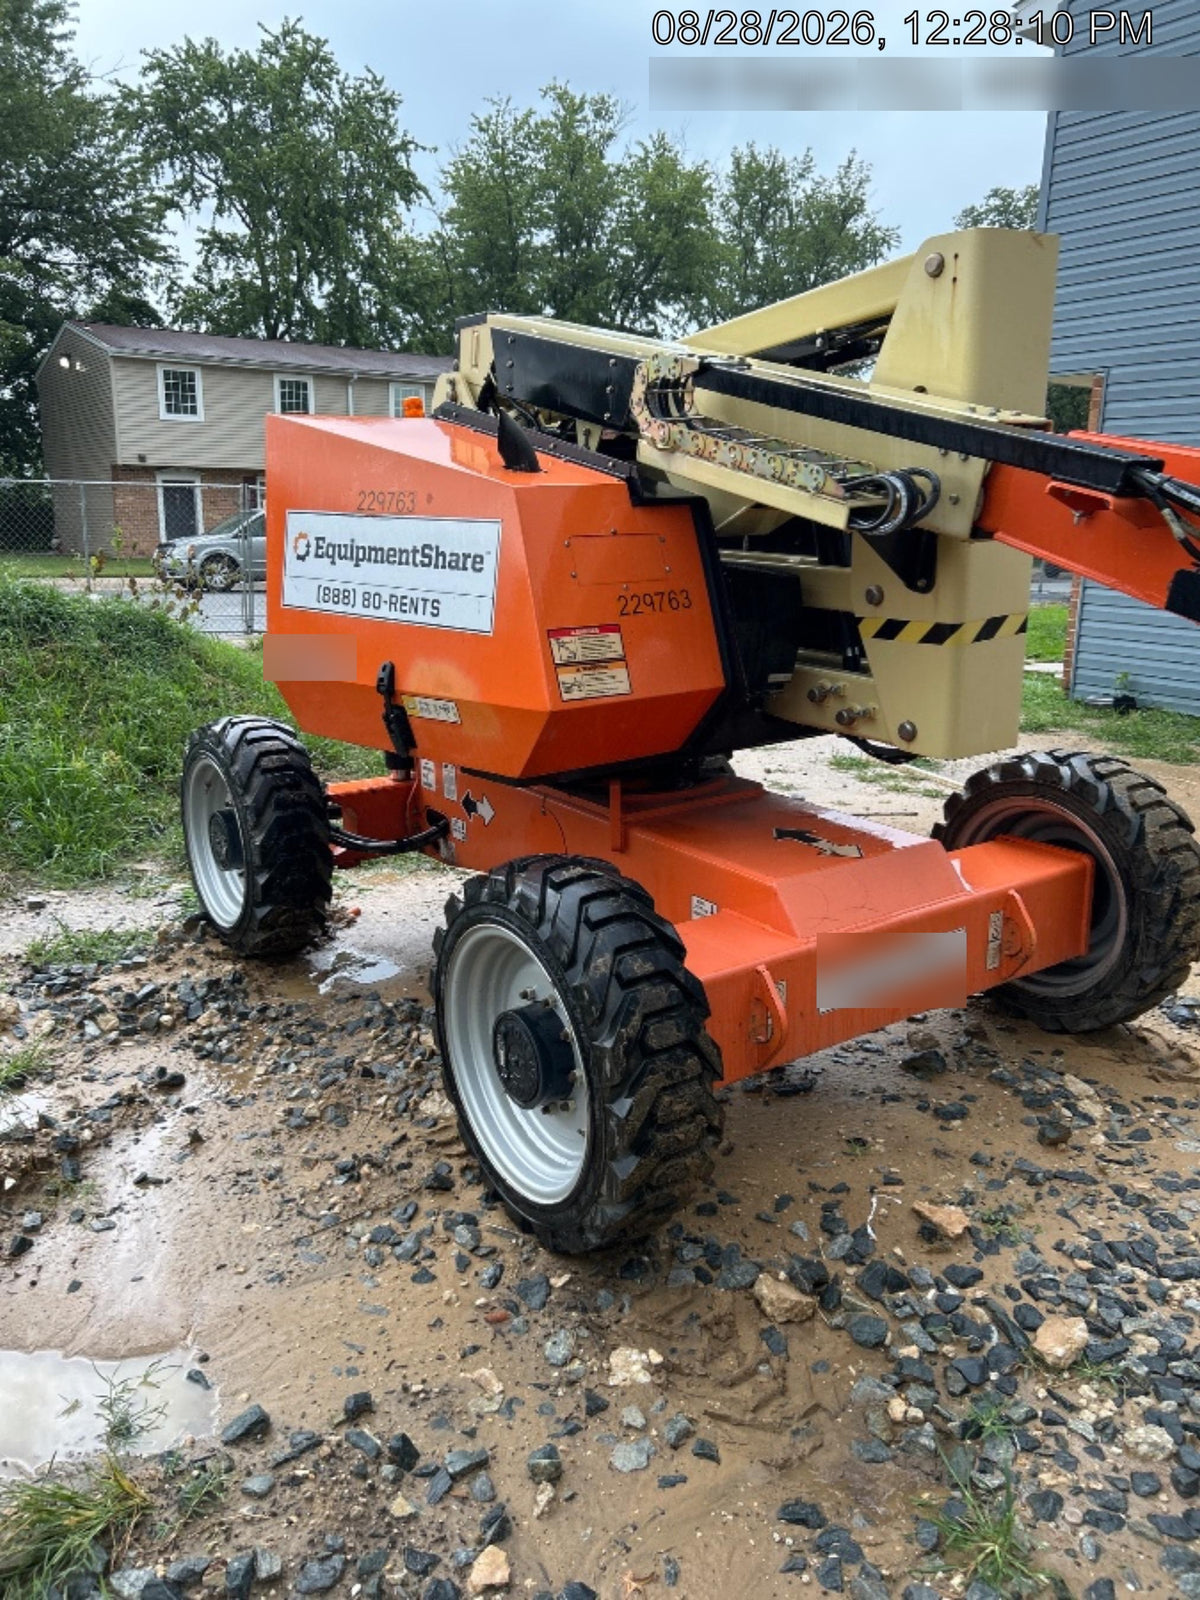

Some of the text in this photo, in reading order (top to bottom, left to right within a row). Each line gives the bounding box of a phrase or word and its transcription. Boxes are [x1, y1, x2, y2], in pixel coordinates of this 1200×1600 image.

[356, 490, 416, 513] 229763
[313, 536, 485, 573] EquipmentShare
[316, 584, 442, 618] (888) 80-RENTS
[617, 588, 692, 616] 229763
